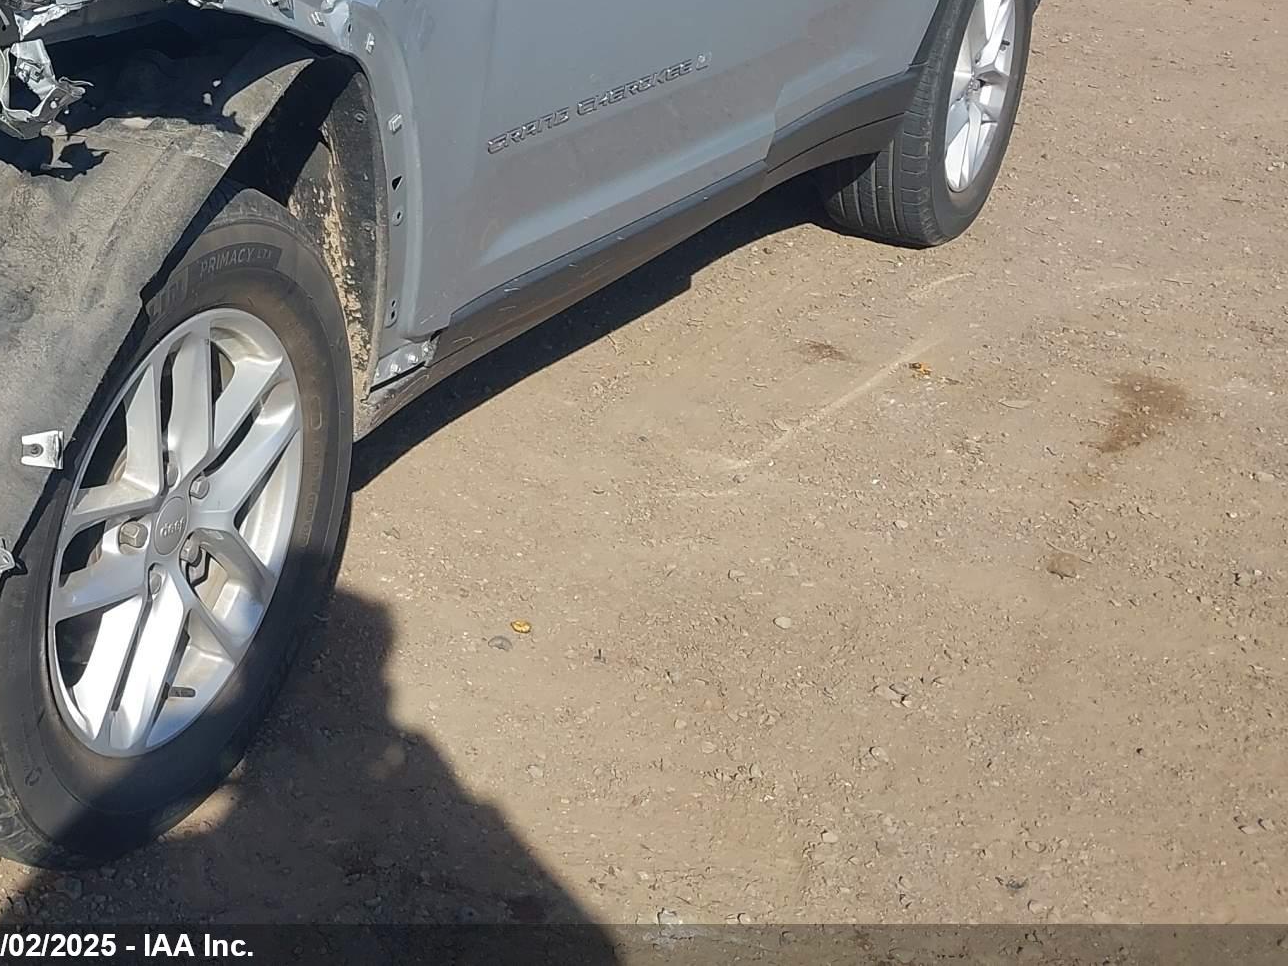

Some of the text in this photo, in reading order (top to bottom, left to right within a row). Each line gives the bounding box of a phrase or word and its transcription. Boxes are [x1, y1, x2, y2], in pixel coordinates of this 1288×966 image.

[487, 105, 570, 155] GRAND
[576, 58, 694, 116] CHEROKEE
[199, 246, 255, 279] PRIMACY
